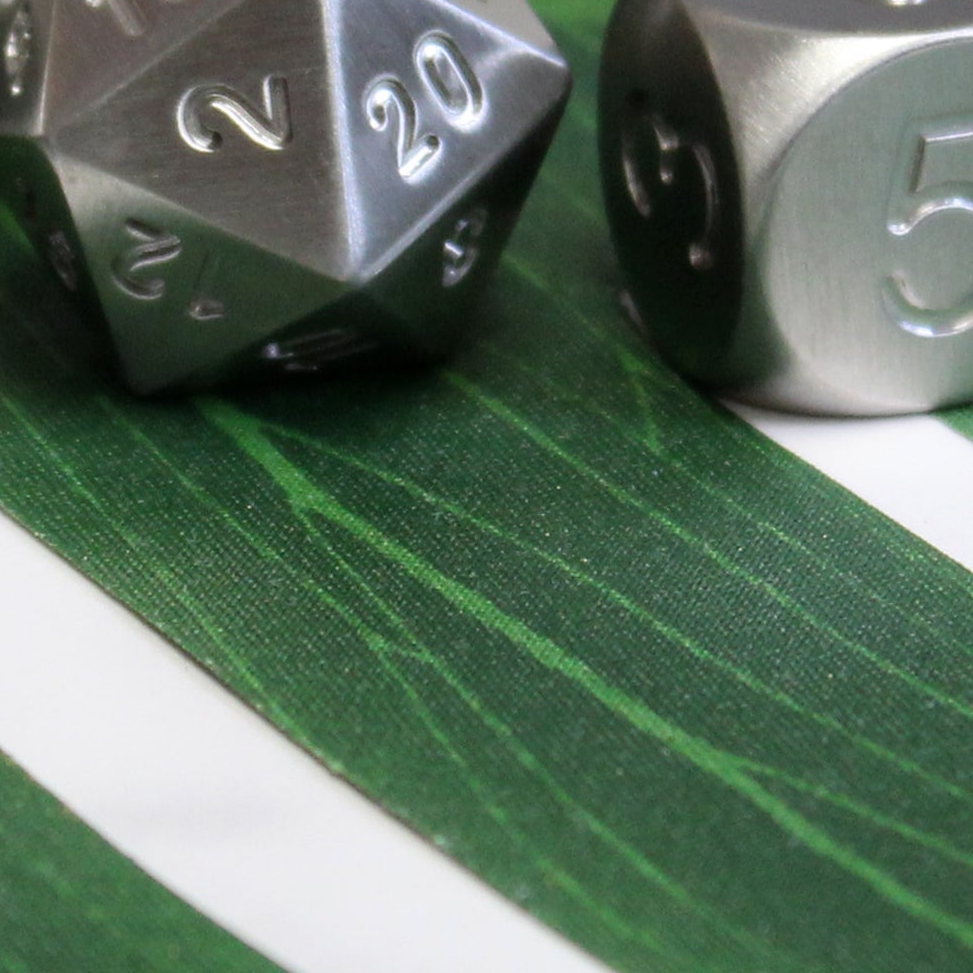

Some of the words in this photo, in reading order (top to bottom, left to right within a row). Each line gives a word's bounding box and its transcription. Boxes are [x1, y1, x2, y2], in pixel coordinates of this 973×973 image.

[175, 73, 295, 155] 2
[361, 30, 490, 185] 20
[882, 109, 973, 340] 5
